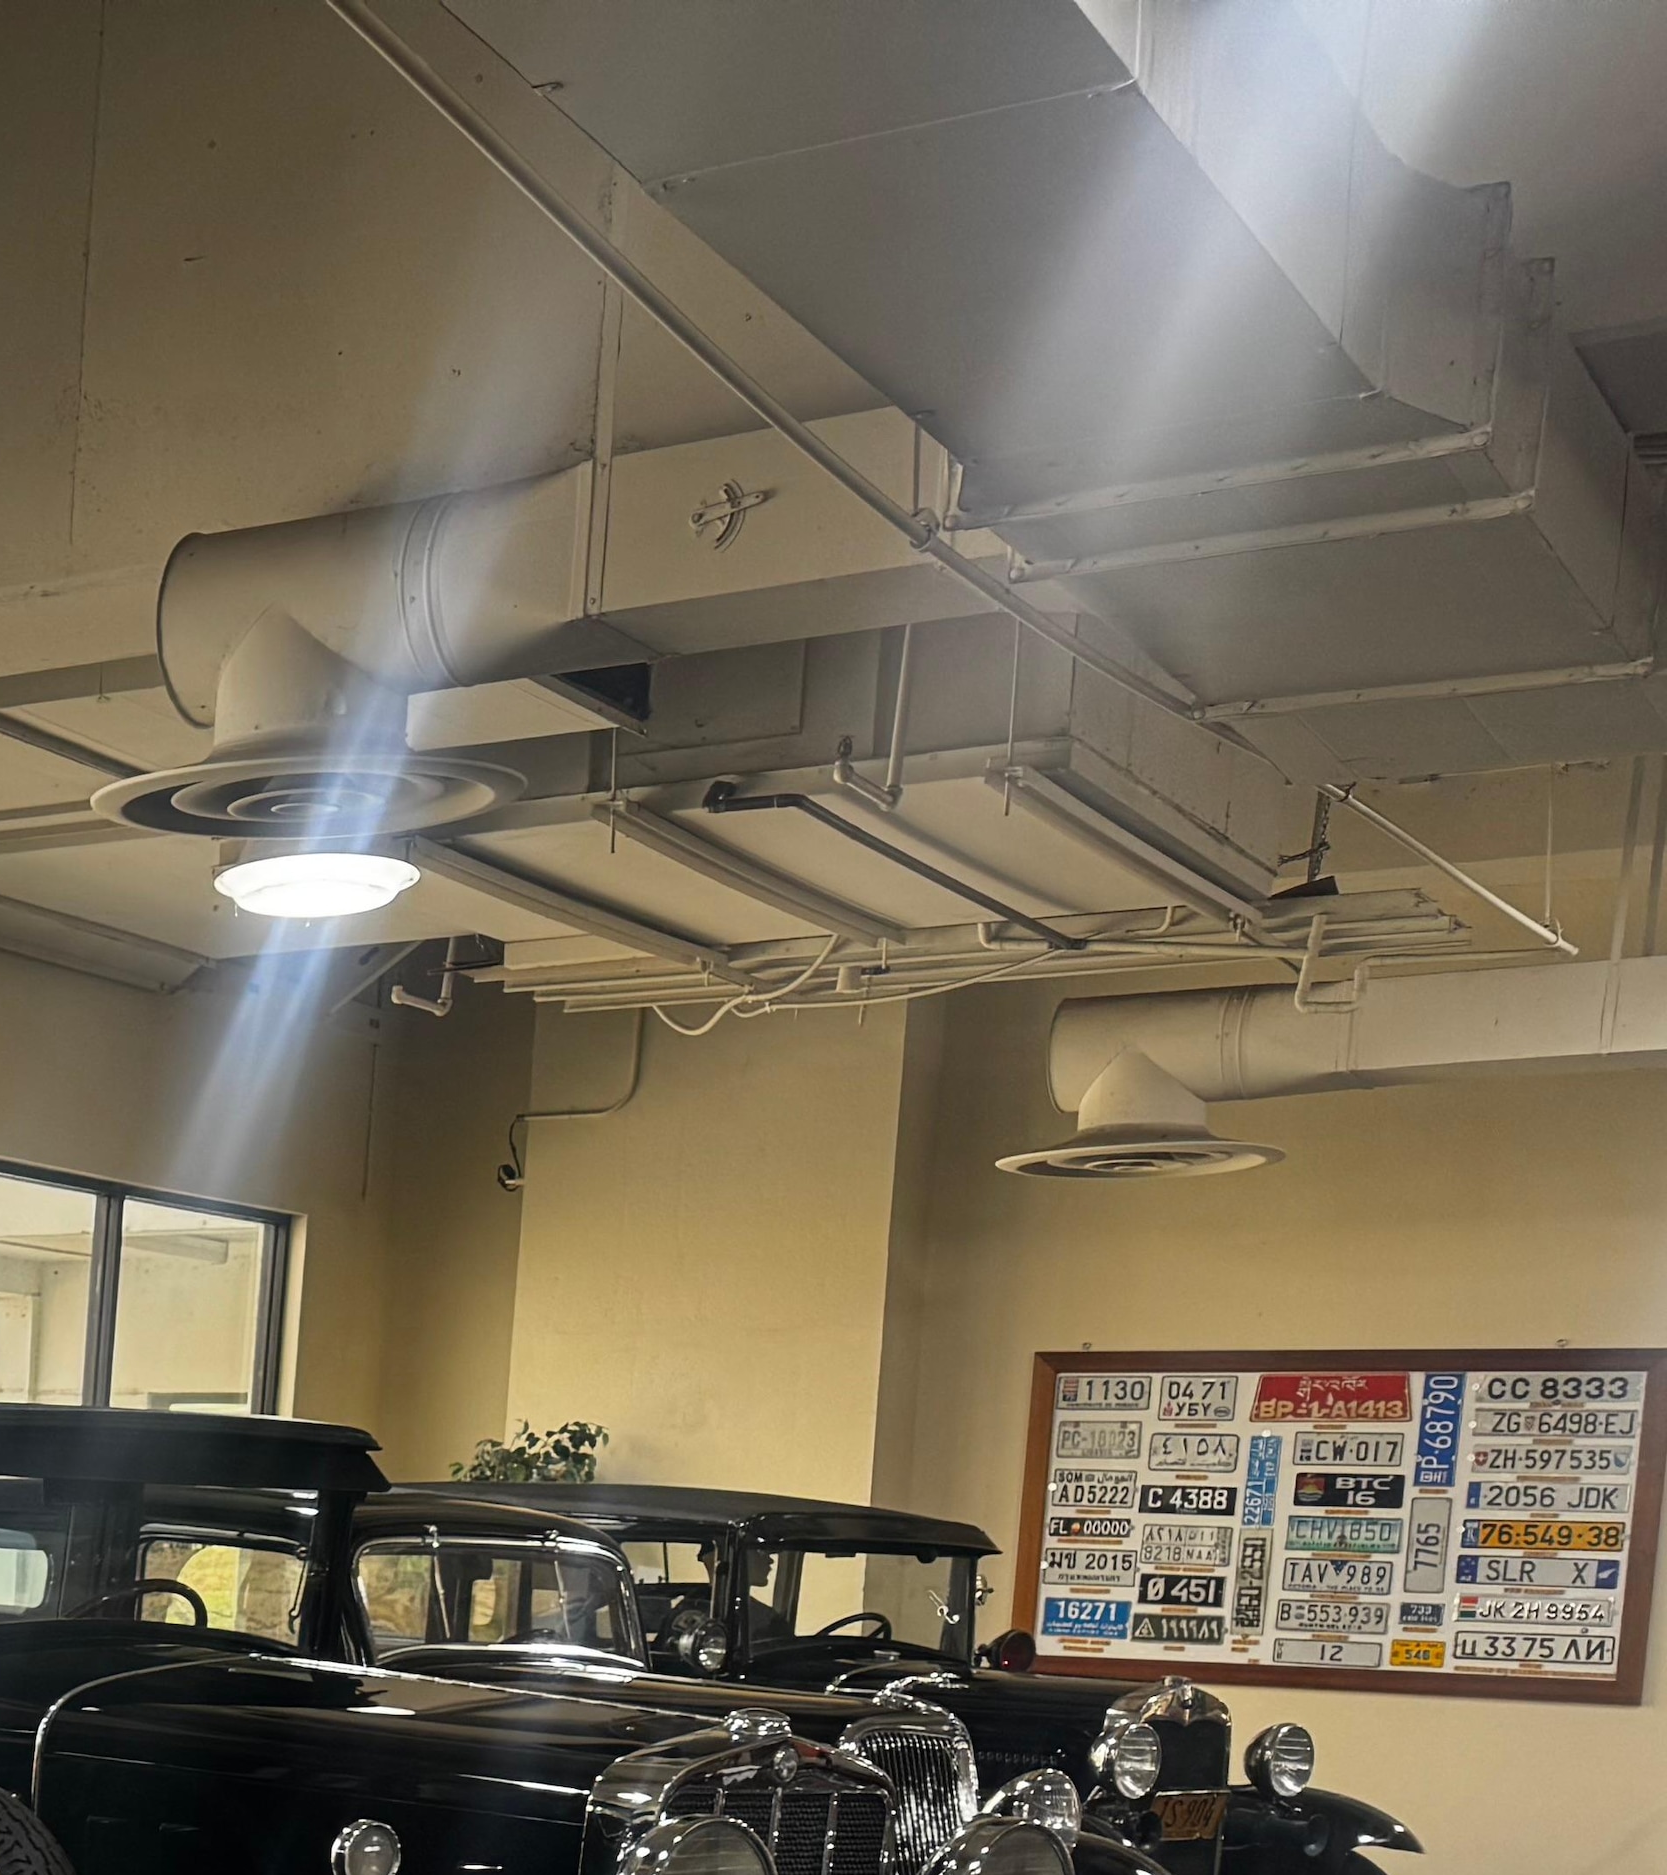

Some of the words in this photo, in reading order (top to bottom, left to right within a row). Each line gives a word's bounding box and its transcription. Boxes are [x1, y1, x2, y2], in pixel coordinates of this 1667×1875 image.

[1085, 1380, 1145, 1400] 1130
[1487, 1377, 1530, 1399] CC
[1540, 1377, 1629, 1399] 8333
[1491, 1412, 1521, 1434] ZG
[1058, 1472, 1083, 1483] SOM
[1335, 1476, 1393, 1491] BTC
[1148, 1488, 1164, 1509] C
[1169, 1488, 1228, 1510] 4388
[1346, 1490, 1377, 1506] 16
[1486, 1485, 1556, 1508] 2056
[1567, 1487, 1619, 1510] JDK
[1049, 1521, 1067, 1534] FL
[1083, 1521, 1130, 1536] 00000
[1143, 1545, 1182, 1562] 8218
[1413, 1522, 1441, 1572] 7765
[1085, 1552, 1133, 1572] 2015
[1486, 1560, 1536, 1583] SLR
[1571, 1561, 1589, 1585] X
[1288, 1561, 1329, 1585] TAV
[1346, 1564, 1387, 1586] 989
[1170, 1578, 1215, 1603] 451
[1056, 1600, 1117, 1621] 16271
[1319, 1644, 1344, 1662] 12
